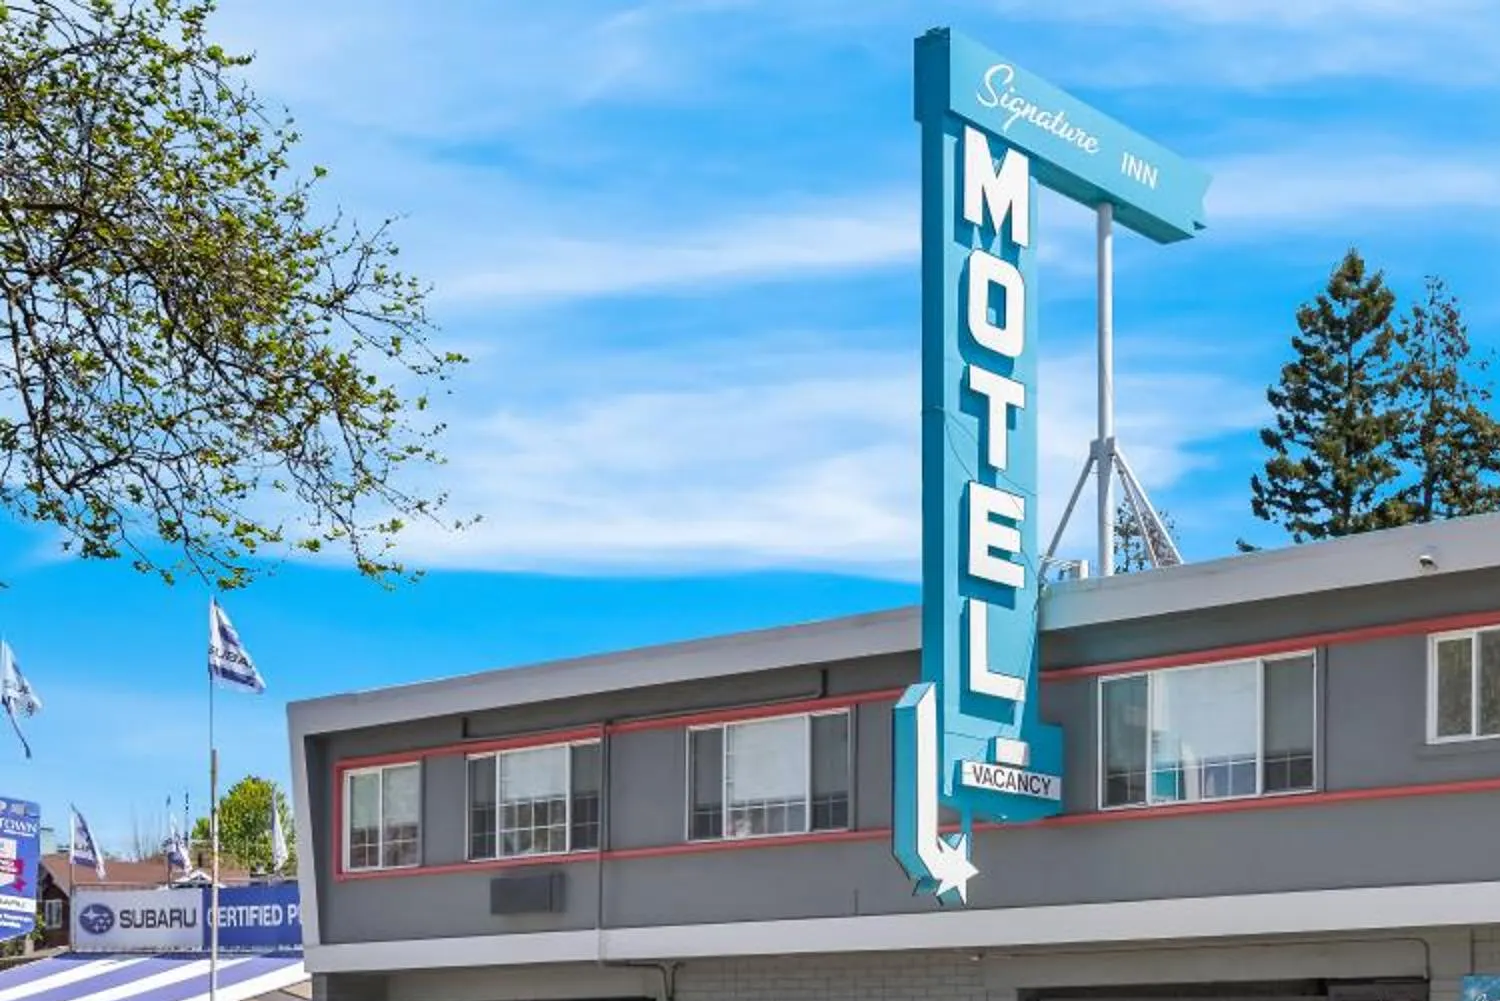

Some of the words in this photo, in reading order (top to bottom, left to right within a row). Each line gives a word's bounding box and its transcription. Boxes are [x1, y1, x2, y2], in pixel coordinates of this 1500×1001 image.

[976, 63, 1101, 154] Signature
[1120, 152, 1160, 190] INN
[963, 124, 1031, 702] MOTEL
[972, 764, 1053, 796] VACANCY
[119, 908, 197, 929] SUBARU
